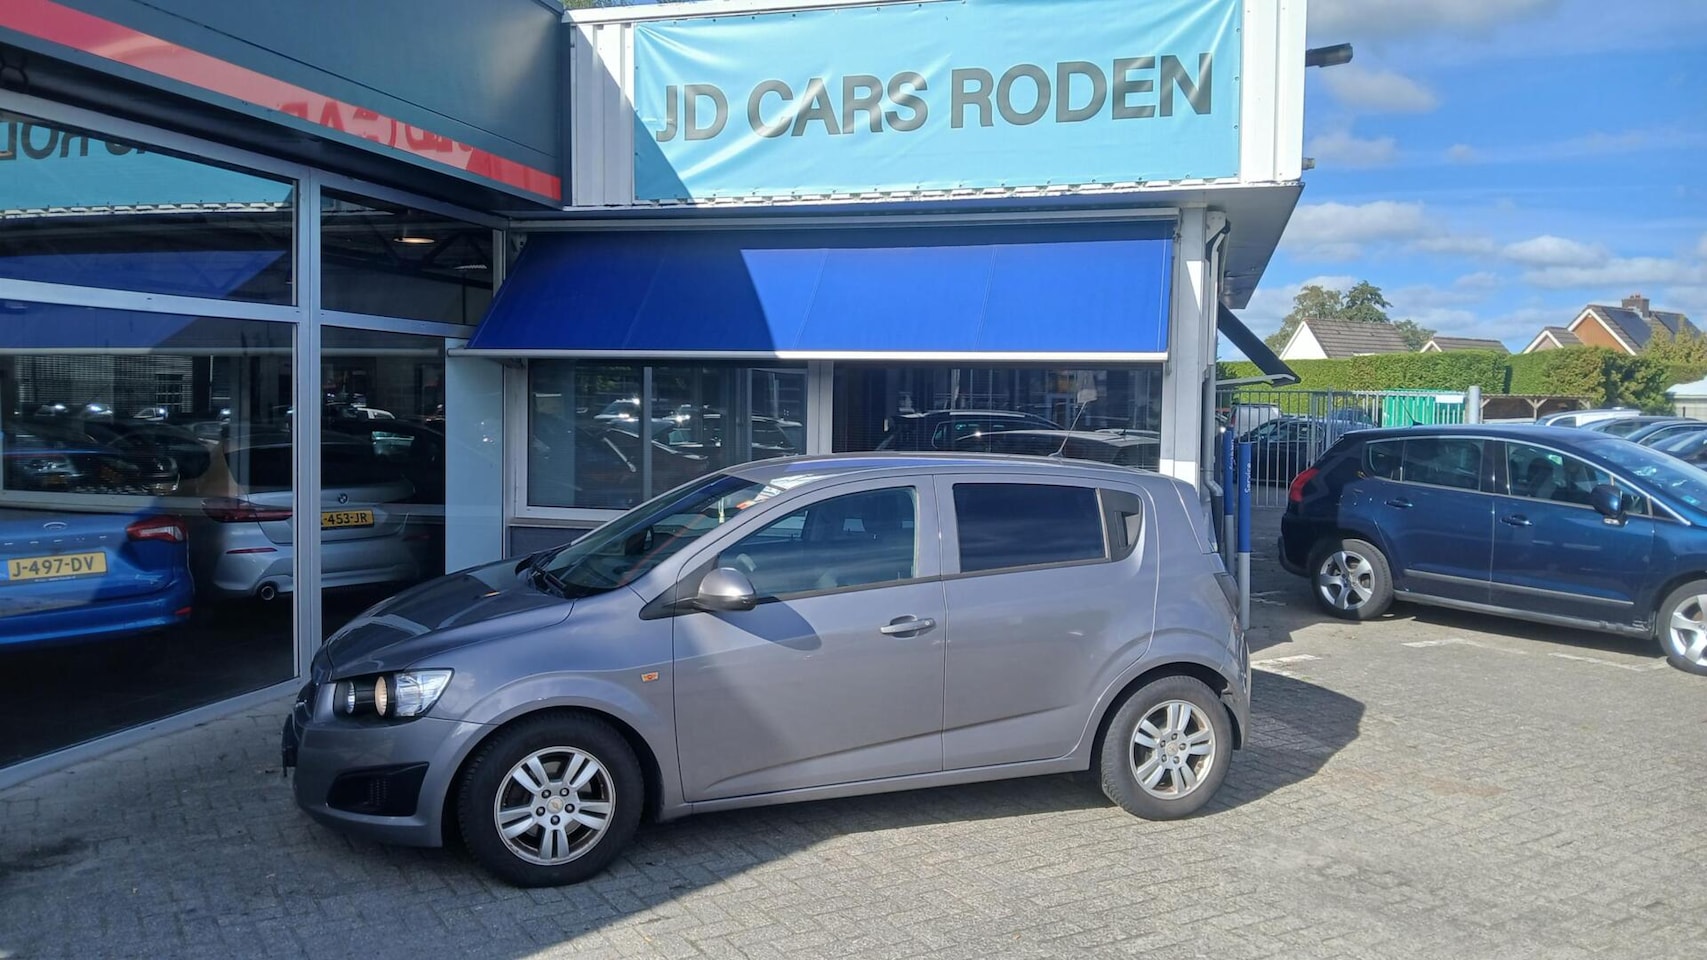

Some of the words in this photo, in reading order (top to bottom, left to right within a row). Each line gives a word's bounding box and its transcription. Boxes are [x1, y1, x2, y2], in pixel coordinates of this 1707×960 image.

[656, 84, 728, 142] JD
[747, 71, 928, 138] CARS
[950, 52, 1212, 129] RODEN
[321, 512, 368, 526] -453-JR
[12, 555, 94, 577] J-497-DV
